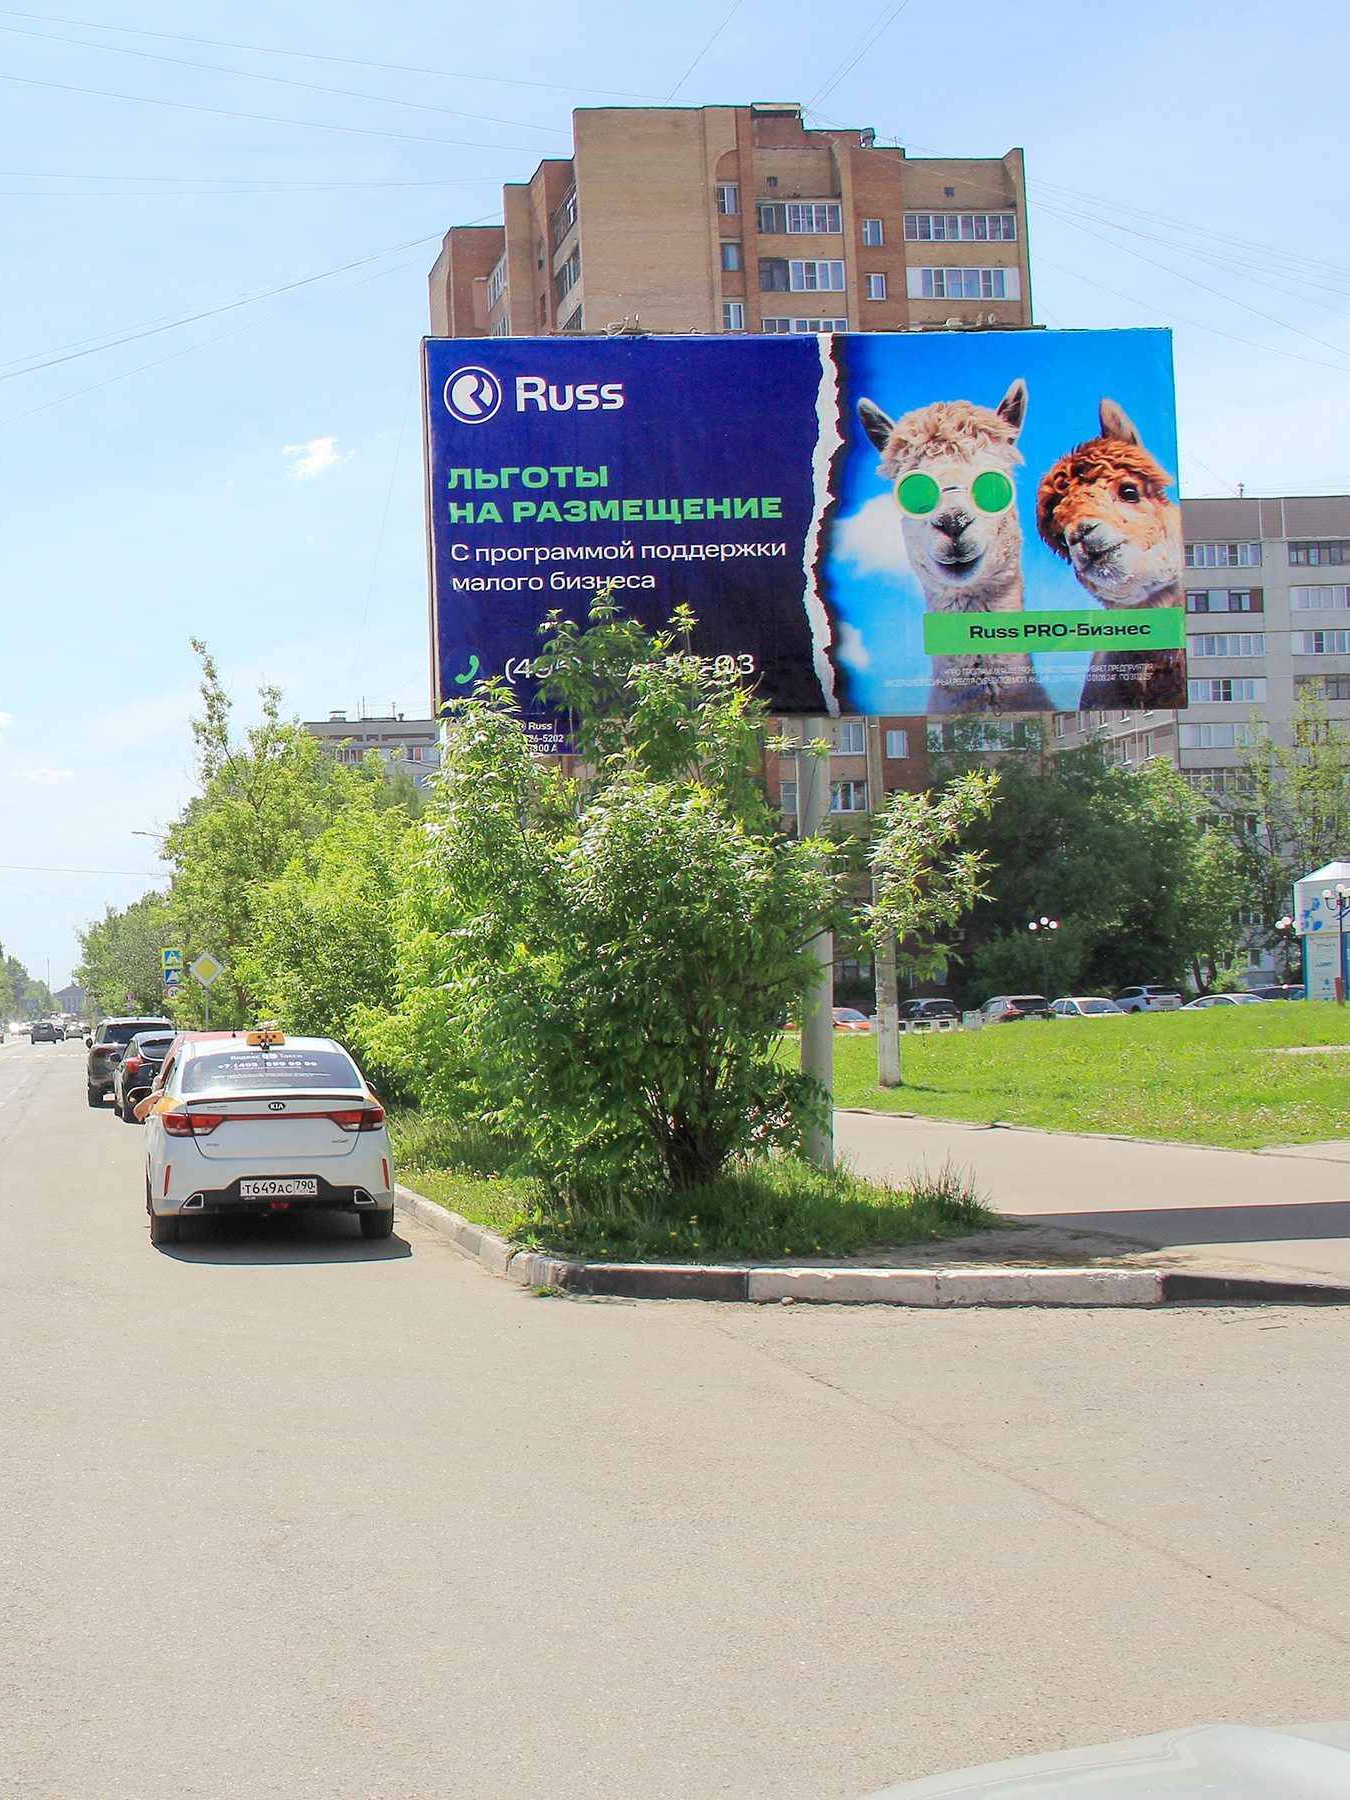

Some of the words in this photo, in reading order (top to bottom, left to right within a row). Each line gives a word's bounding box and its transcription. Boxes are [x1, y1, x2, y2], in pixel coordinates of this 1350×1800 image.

[515, 376, 625, 412] Russ
[448, 466, 608, 490] ЛЬГОТЫ
[449, 501, 503, 524] НА
[513, 497, 783, 525] РАЗМЕЩЕНИЕ
[451, 543, 471, 563] С
[475, 540, 635, 566] программой
[641, 541, 786, 563] поддержки
[452, 575, 543, 592] малого
[550, 570, 656, 590] бизнеса
[969, 625, 1019, 639] Russ
[1023, 623, 1151, 638] PRO-Бизнес
[528, 722, 553, 731] Russ
[269, 1102, 285, 1110] KIA
[245, 1181, 293, 1194] Т649АС
[295, 1180, 314, 1190] 790
